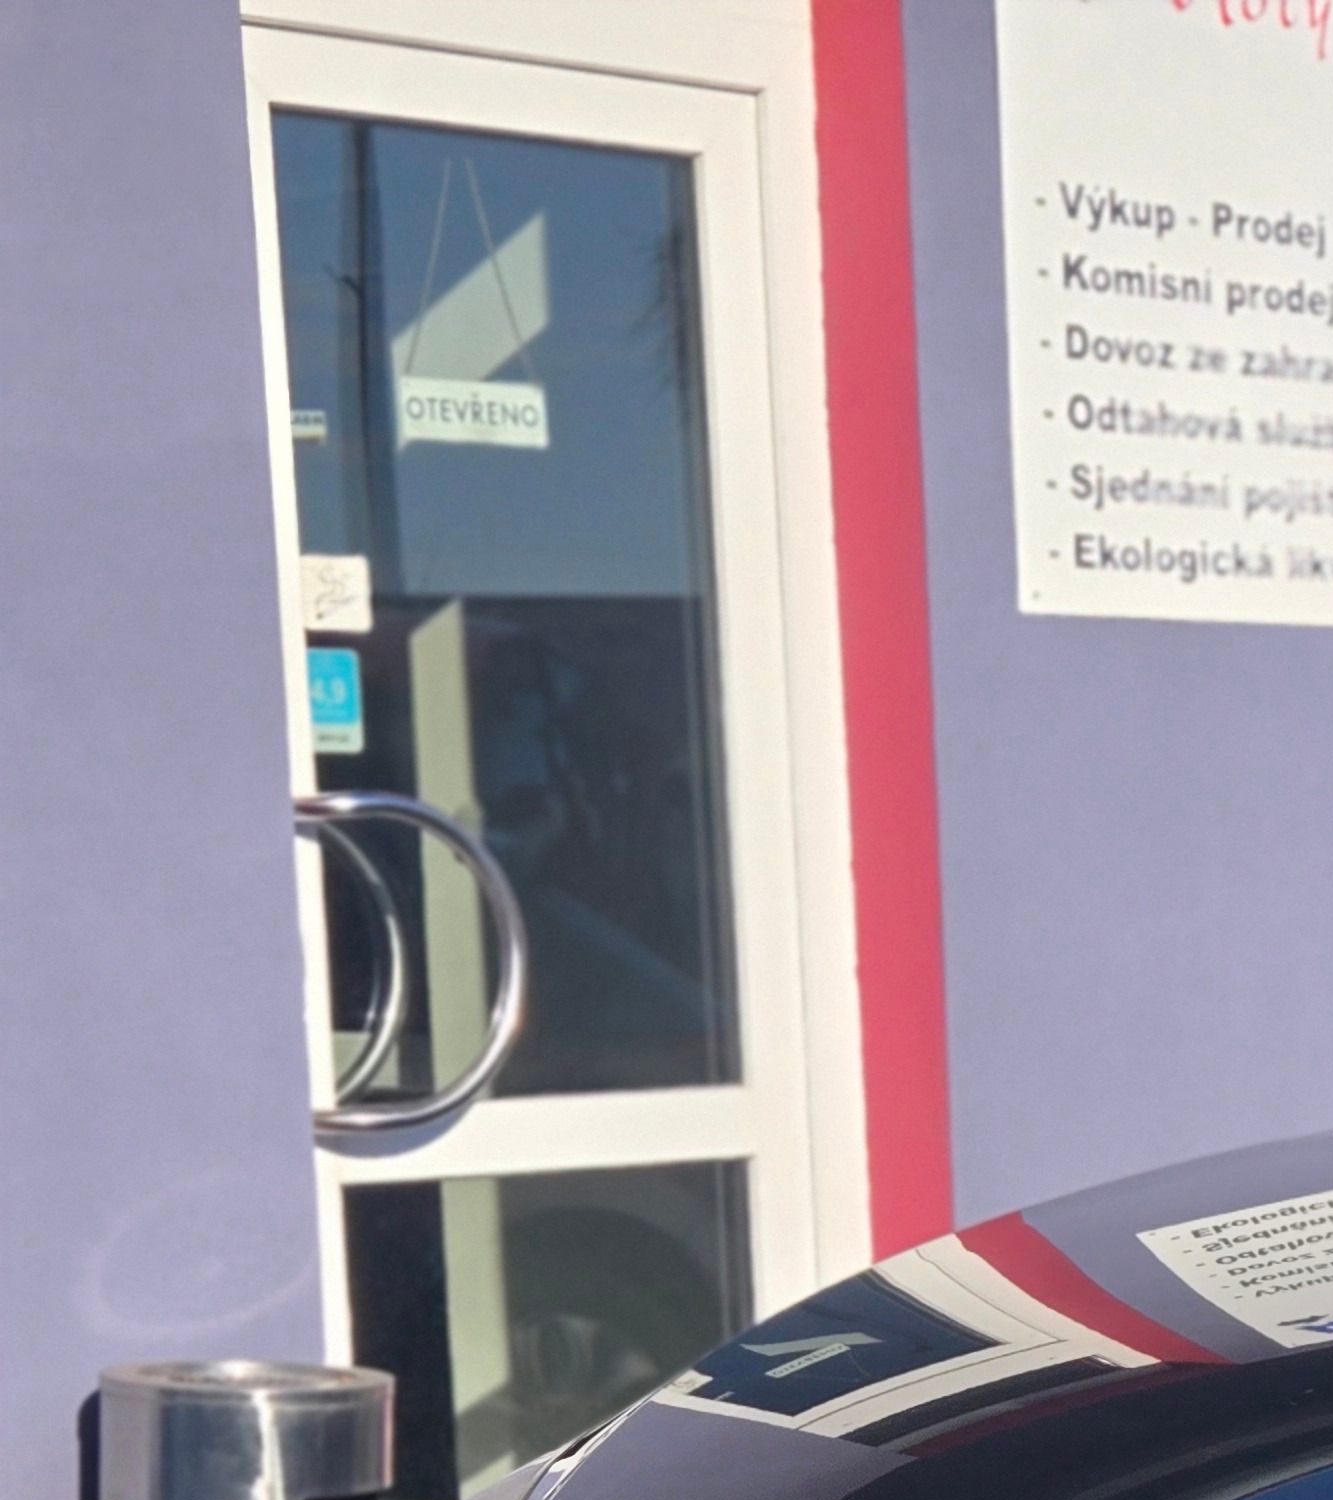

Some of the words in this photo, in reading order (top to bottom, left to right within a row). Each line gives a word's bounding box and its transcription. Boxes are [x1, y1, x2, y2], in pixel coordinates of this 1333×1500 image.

[1058, 181, 1176, 239] Výkup
[1212, 201, 1325, 259] Prodej
[1066, 323, 1175, 369] Dovoz
[1188, 346, 1227, 372] ze
[406, 393, 540, 428] OTEVŘENO
[1067, 393, 1242, 441] Odtahová
[1070, 463, 1230, 511] Sjednání
[1074, 533, 1274, 584] Ekologická
